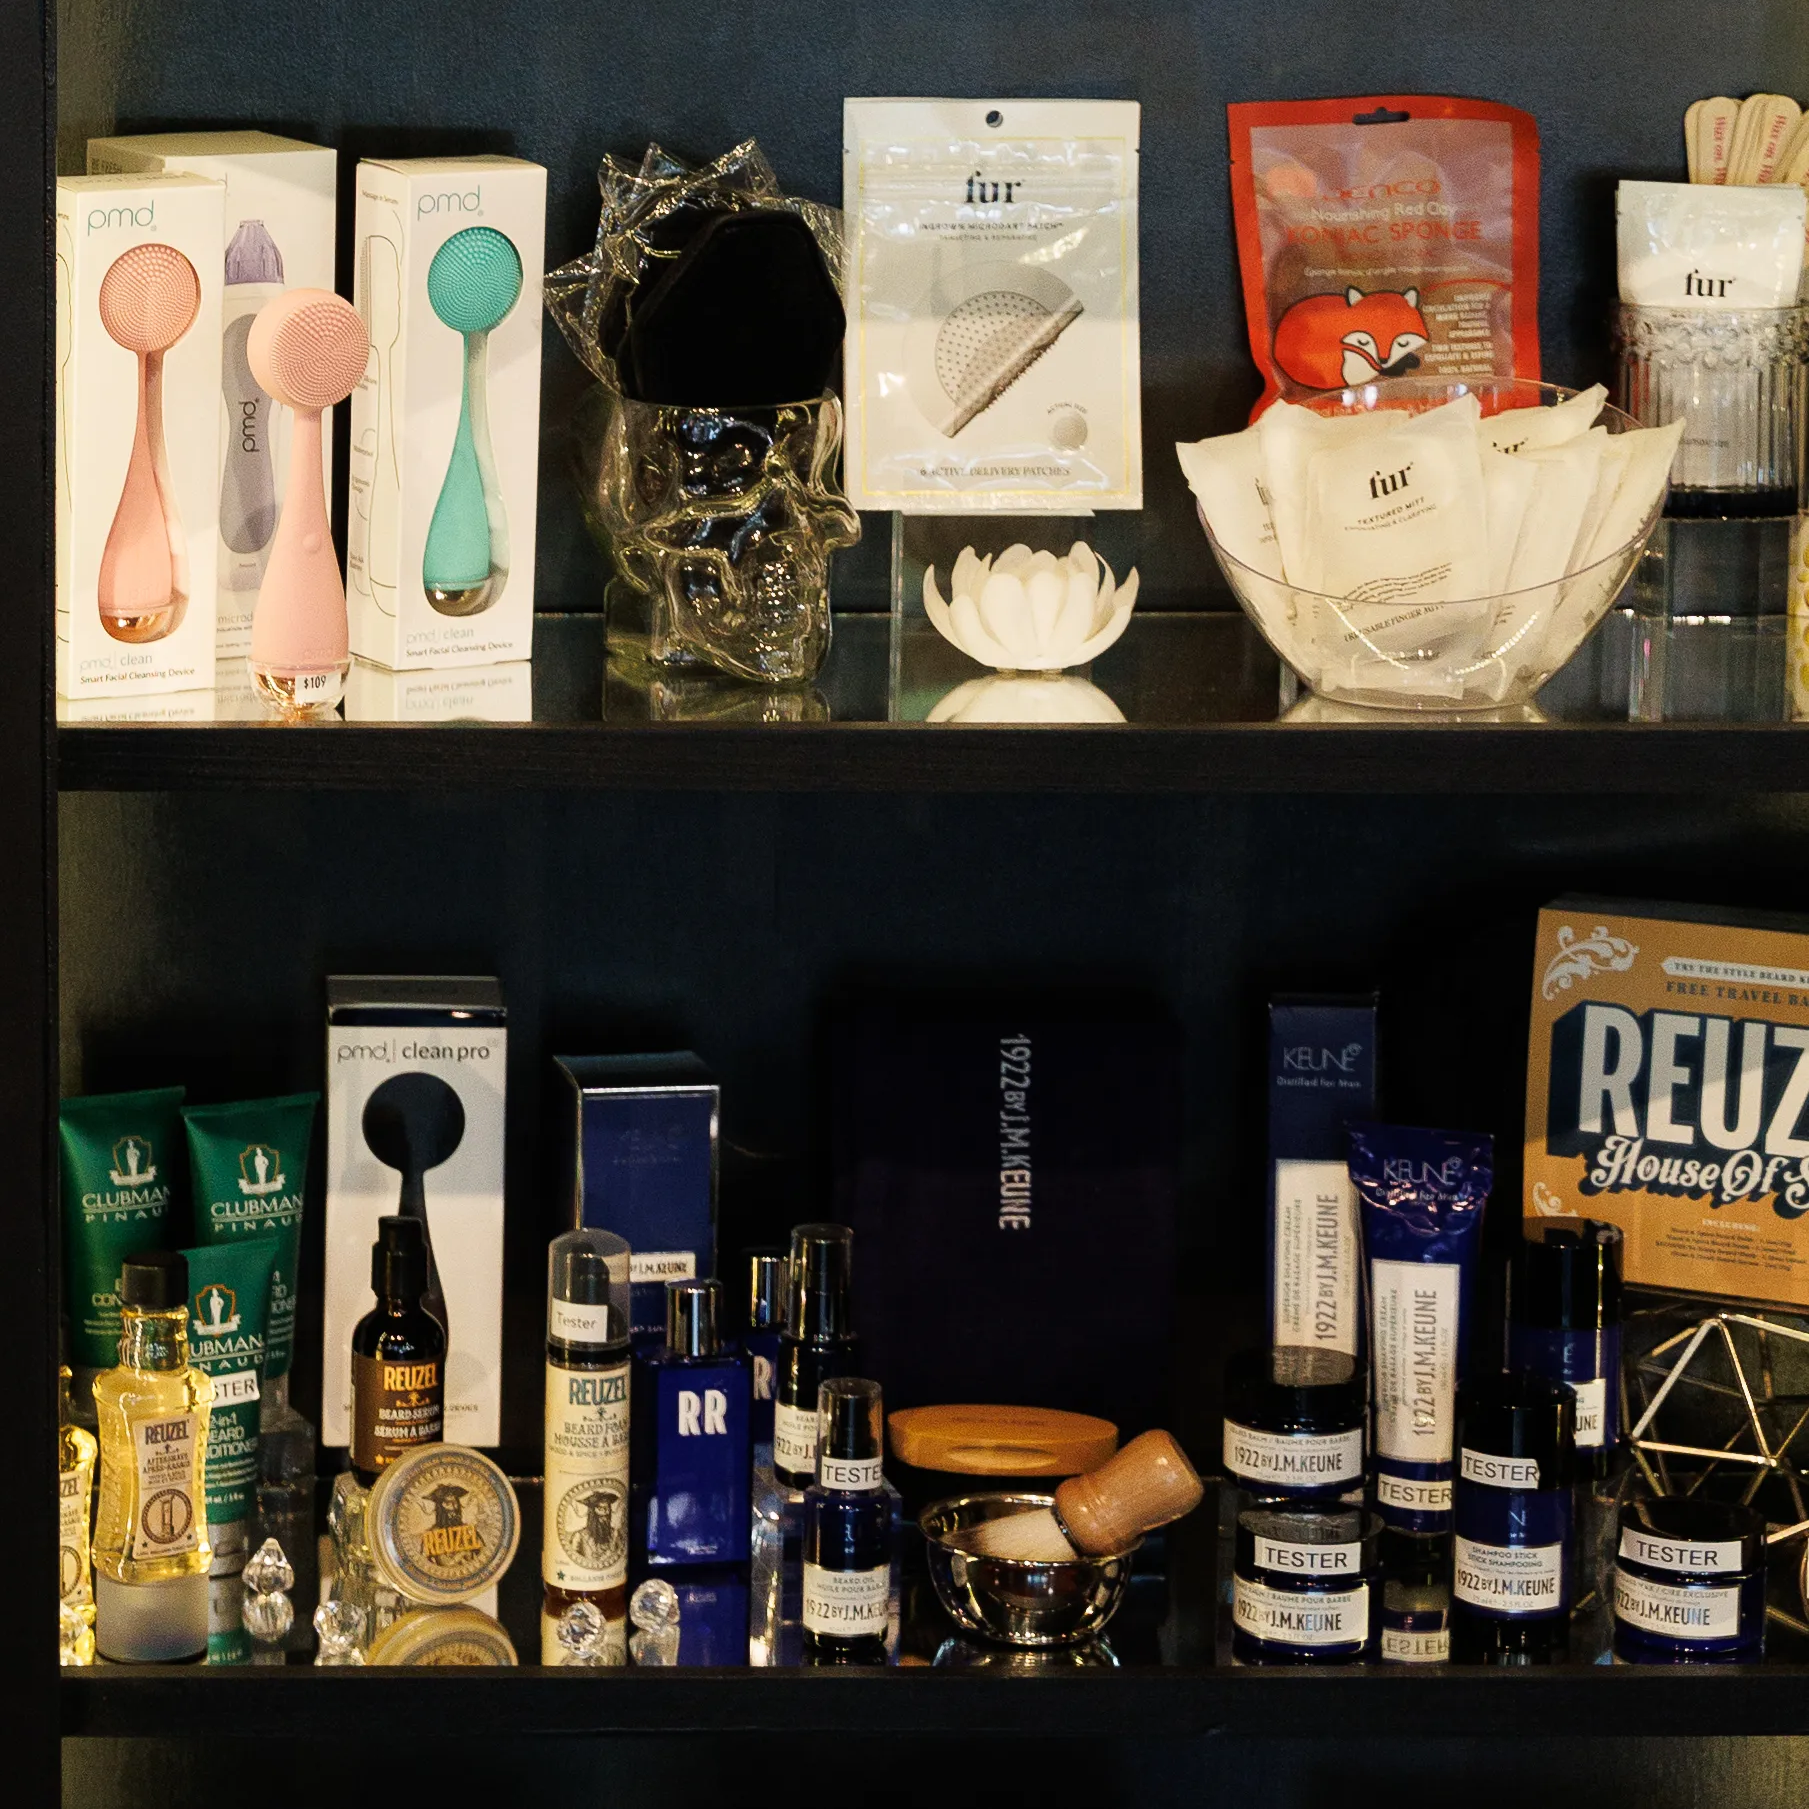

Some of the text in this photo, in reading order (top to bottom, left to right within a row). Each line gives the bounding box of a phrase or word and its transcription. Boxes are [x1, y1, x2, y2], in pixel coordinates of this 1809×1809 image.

[964, 170, 1022, 204] fur
[417, 184, 482, 221] pmd
[1311, 206, 1391, 222] Nourishing
[1395, 202, 1424, 216] Red
[87, 199, 154, 237] pmd
[1389, 220, 1482, 241] SPONGE
[1685, 269, 1734, 299] fur
[241, 401, 258, 453] pmd
[970, 466, 1020, 477] DELIVERY
[1369, 464, 1412, 500] fur
[443, 627, 474, 639] clean
[120, 653, 153, 667] clean
[406, 647, 429, 658] Smart
[80, 667, 195, 685] Smart Facial Cleansing Device
[303, 675, 327, 690] $109
[1698, 963, 1719, 974] THE
[1722, 966, 1756, 980] STYLE
[1759, 969, 1796, 983] BEARD
[1666, 980, 1782, 1005] FREE TRAVEL
[402, 1040, 454, 1060] clean
[457, 1045, 490, 1062] pro
[1283, 1045, 1357, 1073] KEUNE
[999, 1033, 1032, 1230] 1922 BY J.M.KEUNE
[1384, 1157, 1458, 1185] KEUNE
[1591, 1135, 1721, 1191] House
[210, 1192, 304, 1217] CLUBMAN
[1315, 1194, 1339, 1341] 1922 BY J.M.KEUNE
[556, 1311, 597, 1330] Tester
[191, 1334, 265, 1357] UBMAN
[1414, 1289, 1438, 1380] J.M.KEUNE
[214, 1378, 257, 1399] STER
[384, 1362, 437, 1391] REUZEL
[1417, 1380, 1432, 1395] BY
[569, 1373, 628, 1406] REUZEL
[379, 1408, 409, 1420] BEARD
[678, 1389, 728, 1436] RR
[145, 1421, 190, 1445] REUZEL
[564, 1421, 603, 1434] BEARD
[1234, 1446, 1343, 1472] 1922 BY J.M.KEUNE
[1464, 1455, 1539, 1481] TESTER
[1380, 1482, 1452, 1504] TESTER
[422, 1523, 483, 1557] REUZEL
[1265, 1547, 1348, 1569] TESTER
[1468, 1555, 1491, 1567] STICK
[1471, 1546, 1538, 1560] SHAMPOO STICK
[1637, 1539, 1719, 1567] TESTER
[1457, 1569, 1555, 1597] 1922 BY J.M.KEUNE
[1238, 1597, 1342, 1632] 1922 J.M.KEUNE
[1640, 1599, 1711, 1627] J.M.KEUNE
